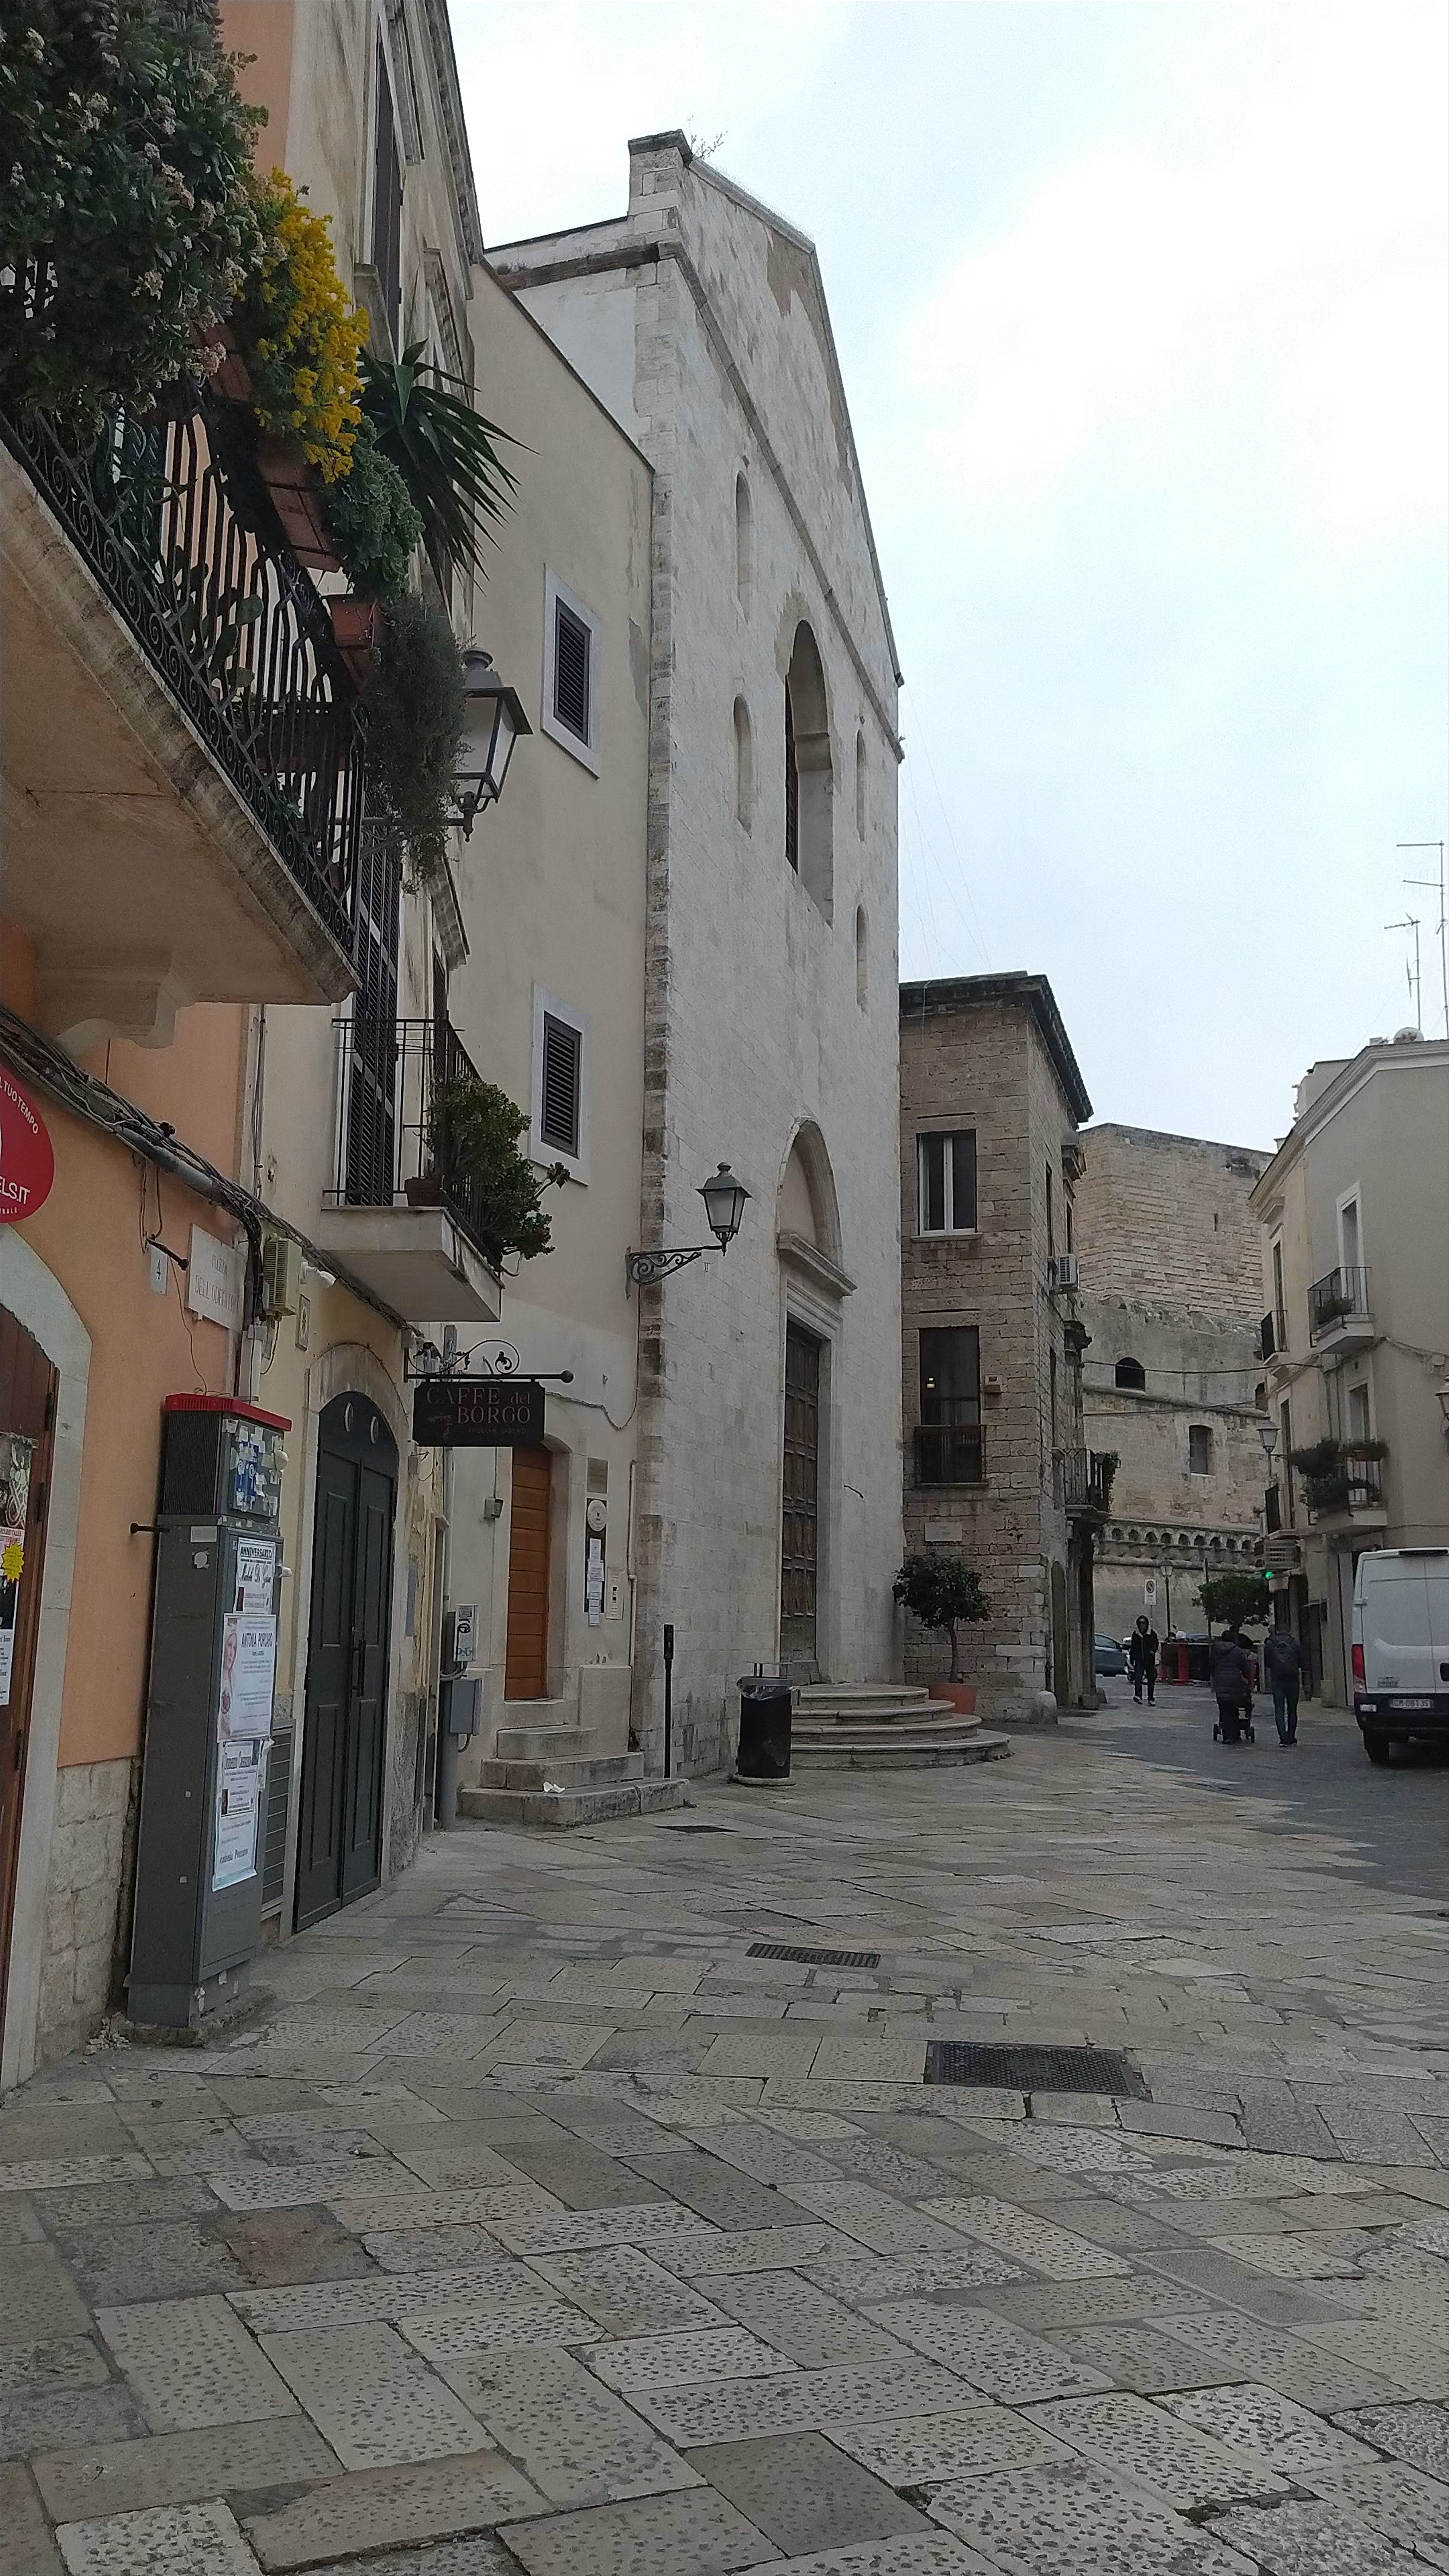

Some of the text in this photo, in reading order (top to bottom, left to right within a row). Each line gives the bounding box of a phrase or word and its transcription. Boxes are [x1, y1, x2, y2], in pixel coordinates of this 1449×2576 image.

[4, 1080, 18, 1102] TUO
[18, 1096, 38, 1134] TEMPO
[156, 1259, 162, 1280] 4
[427, 1387, 530, 1405] CAFFE del
[457, 1406, 531, 1424] BORGO
[240, 1546, 272, 1558] ANNIVERSARIO
